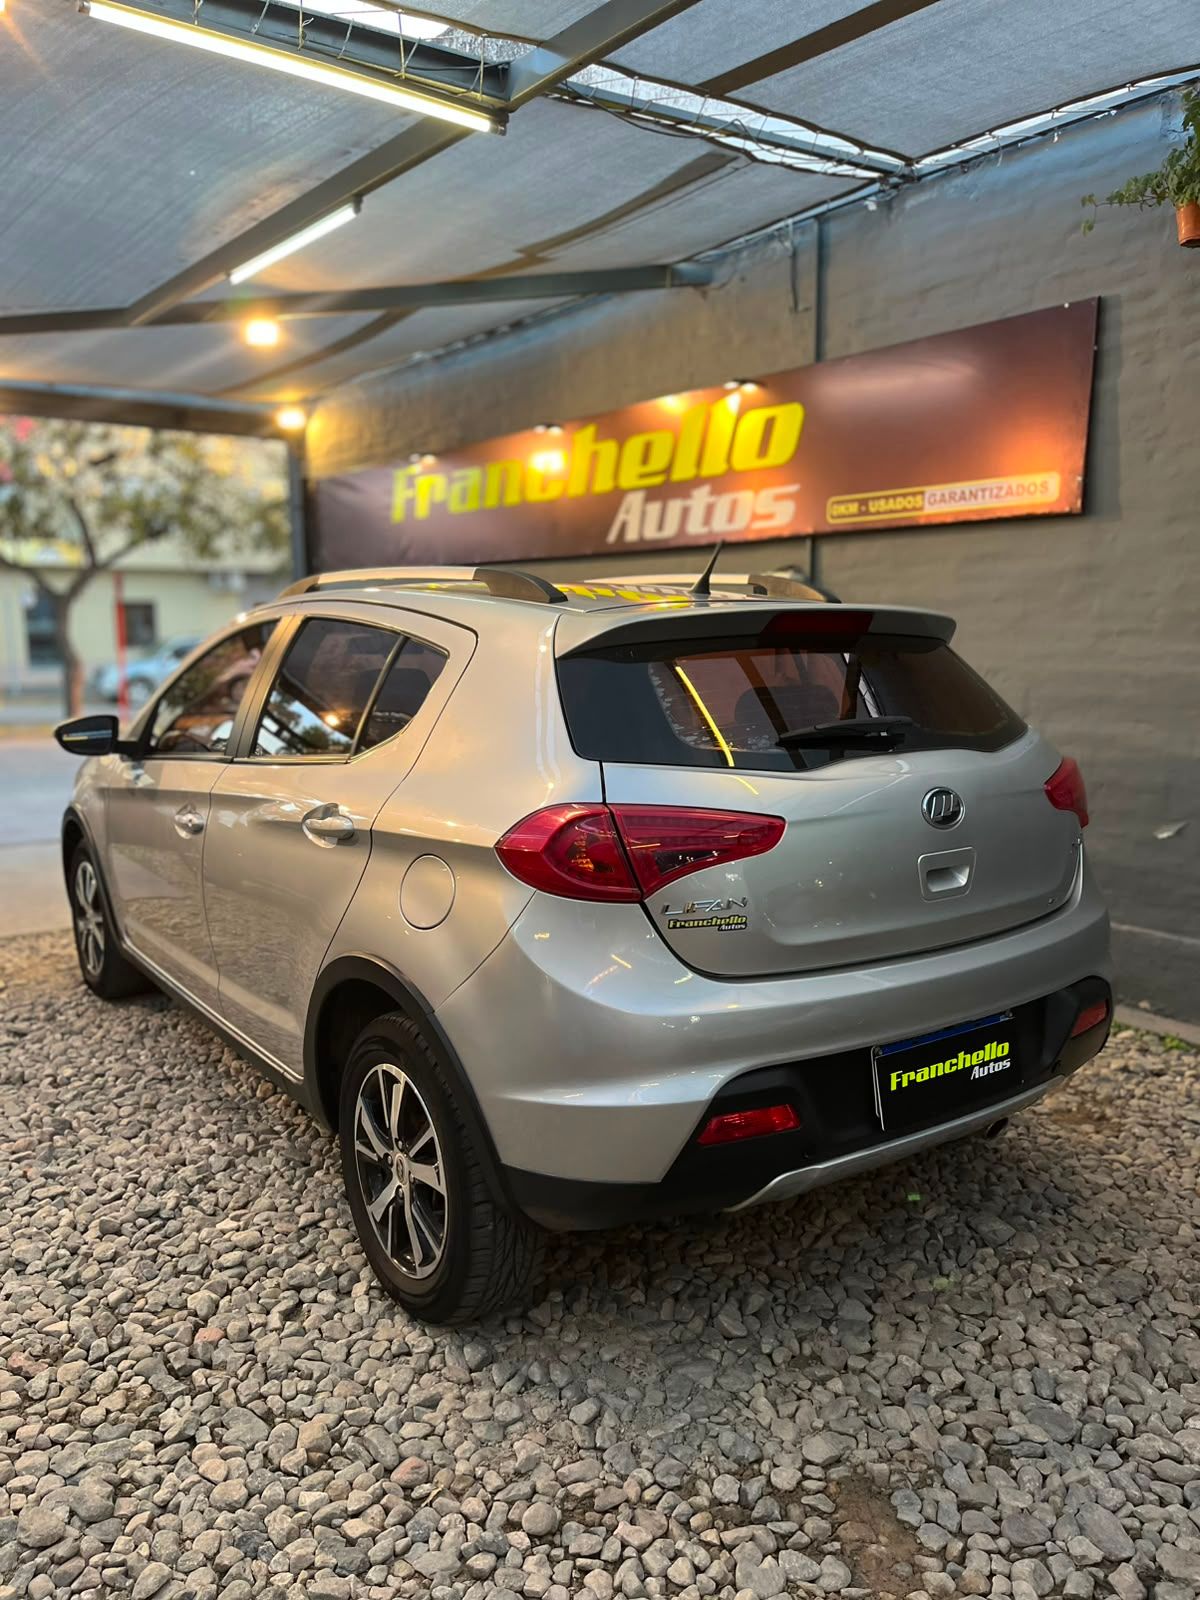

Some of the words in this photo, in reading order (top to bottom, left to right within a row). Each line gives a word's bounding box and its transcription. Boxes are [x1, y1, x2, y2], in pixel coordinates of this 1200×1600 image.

[390, 394, 804, 524] Franchello
[867, 494, 924, 513] USADOS
[927, 479, 1050, 507] GARANTIZADOS
[606, 484, 801, 543] Autos
[661, 897, 748, 915] LIFAN
[668, 914, 747, 929] Franchello
[718, 922, 747, 932] Autos
[889, 1040, 1010, 1092] Franchello
[970, 1058, 1011, 1080] Autos
